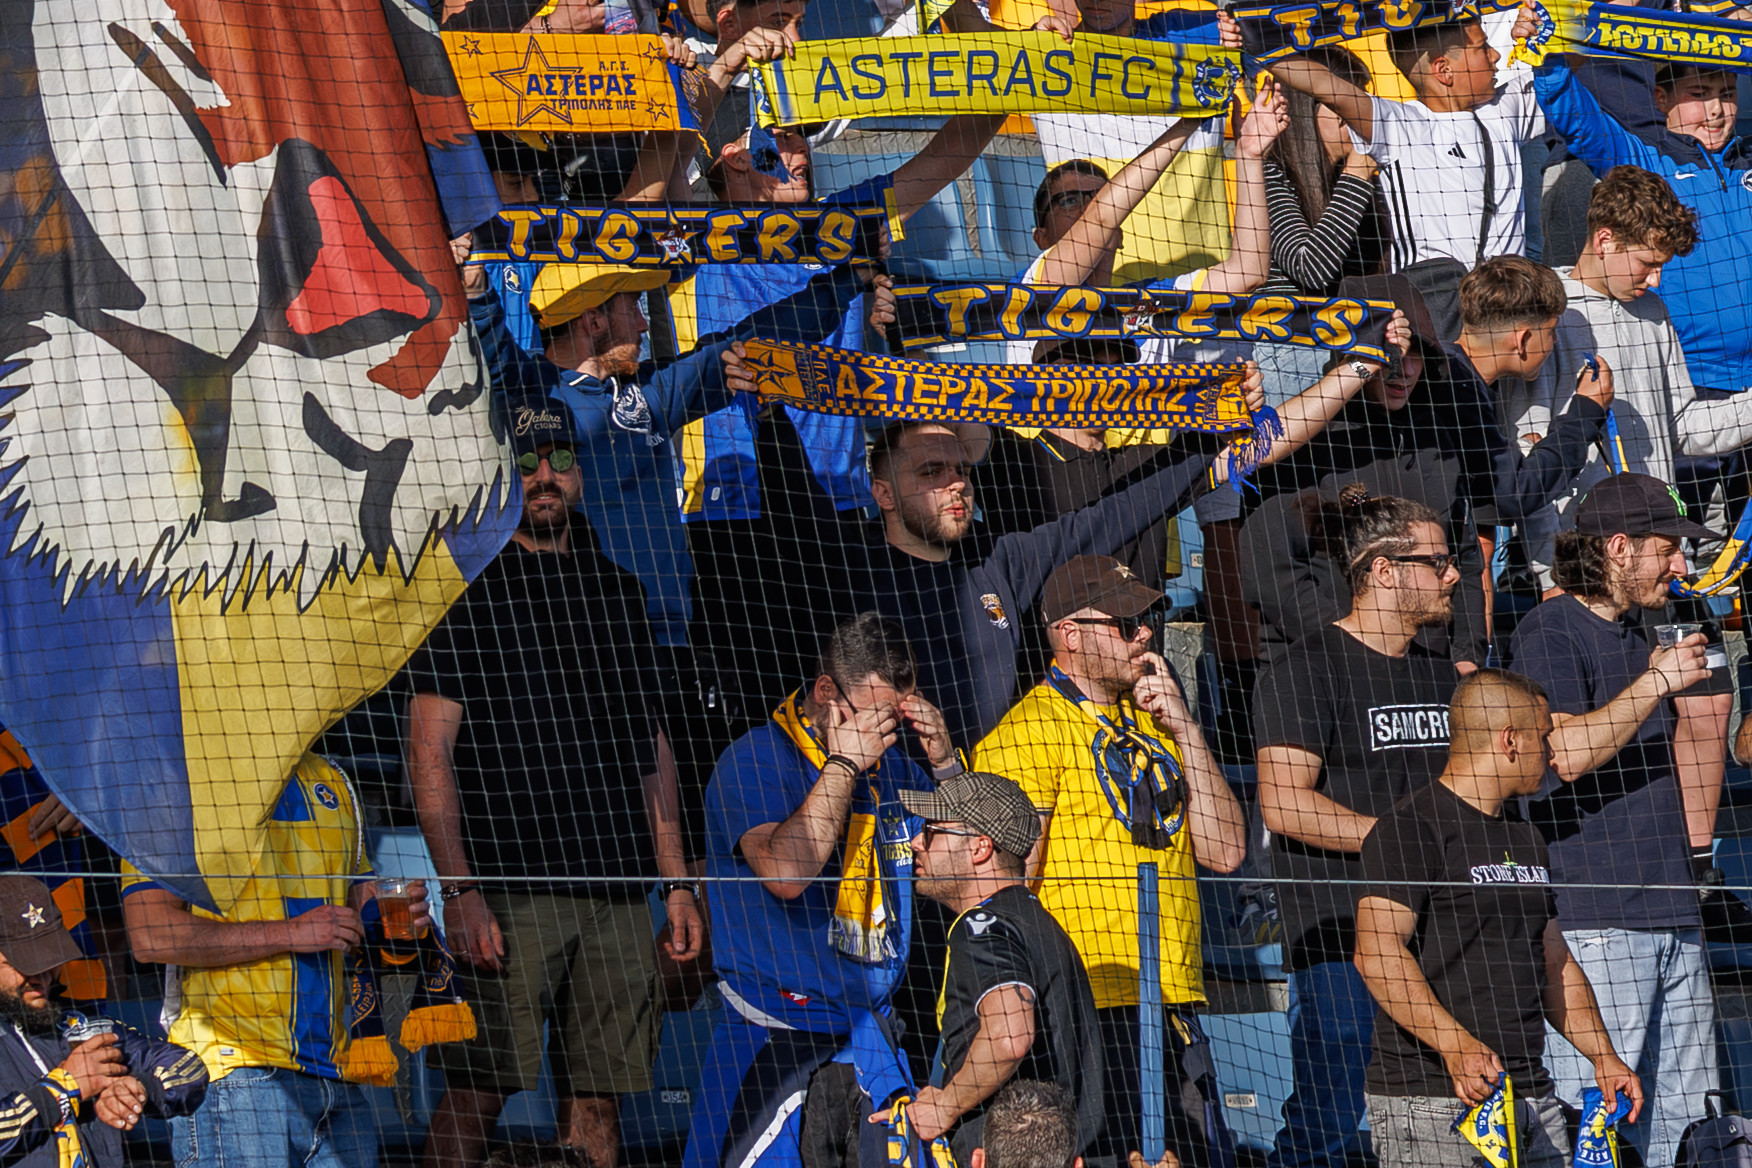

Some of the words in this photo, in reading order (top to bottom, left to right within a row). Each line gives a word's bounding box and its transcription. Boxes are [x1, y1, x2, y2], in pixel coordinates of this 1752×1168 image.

[526, 74, 637, 96] ΑΣΤΕΡΑΣ
[814, 49, 1076, 104] ASTERAS
[1090, 52, 1156, 100] FC
[551, 99, 613, 111] ΤΡΙΠΟΛΗΣ
[616, 99, 636, 110] ΠΑΕ
[497, 206, 858, 262] TIGERS
[928, 284, 1368, 350] TIGERS
[836, 364, 1017, 411] ΑΣΤΕΡΑΣ
[1024, 376, 1200, 414] ΤΡΙΠΟΛΗΣ
[1470, 865, 1515, 885] STONE
